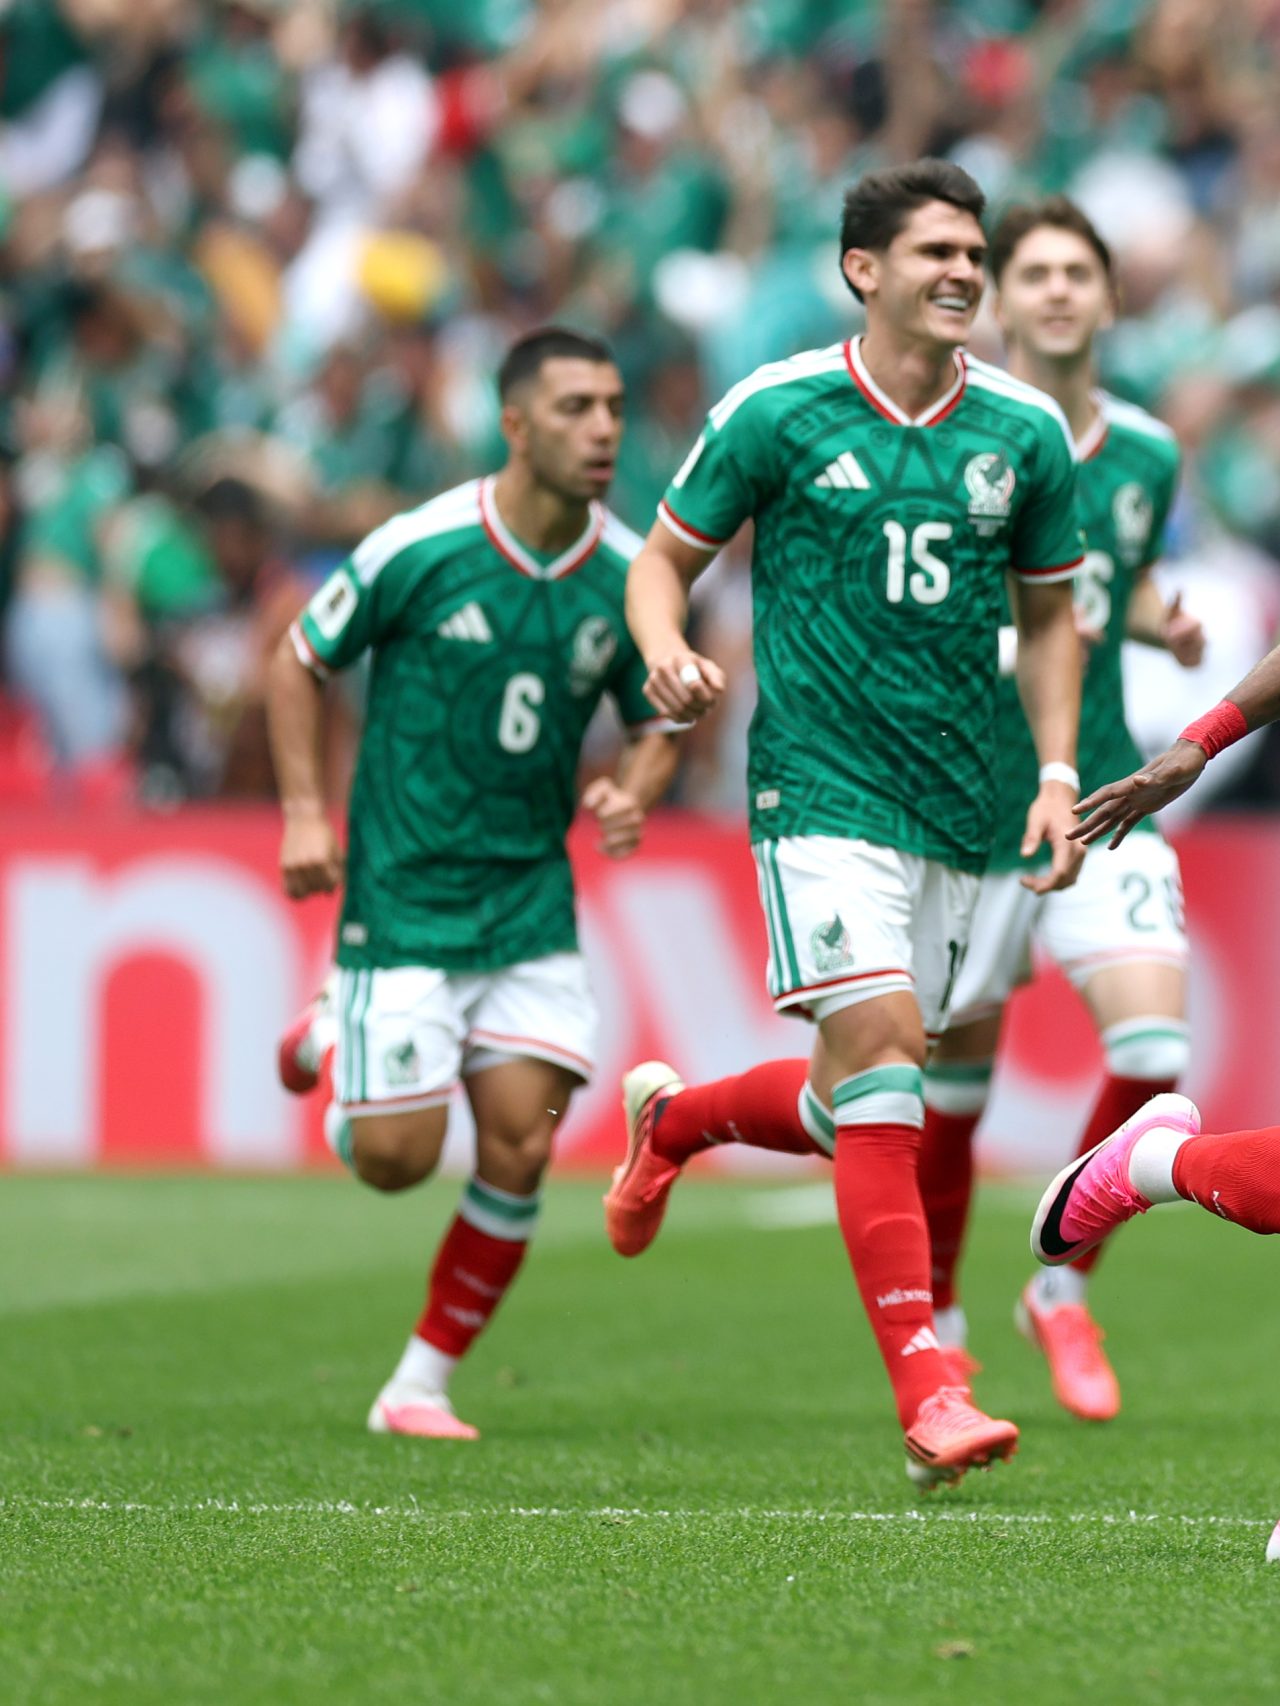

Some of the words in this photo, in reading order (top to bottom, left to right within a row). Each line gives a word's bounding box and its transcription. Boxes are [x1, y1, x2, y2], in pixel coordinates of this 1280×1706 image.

[882, 519, 954, 605] 15
[1073, 549, 1116, 636] 6
[498, 671, 546, 754] 6
